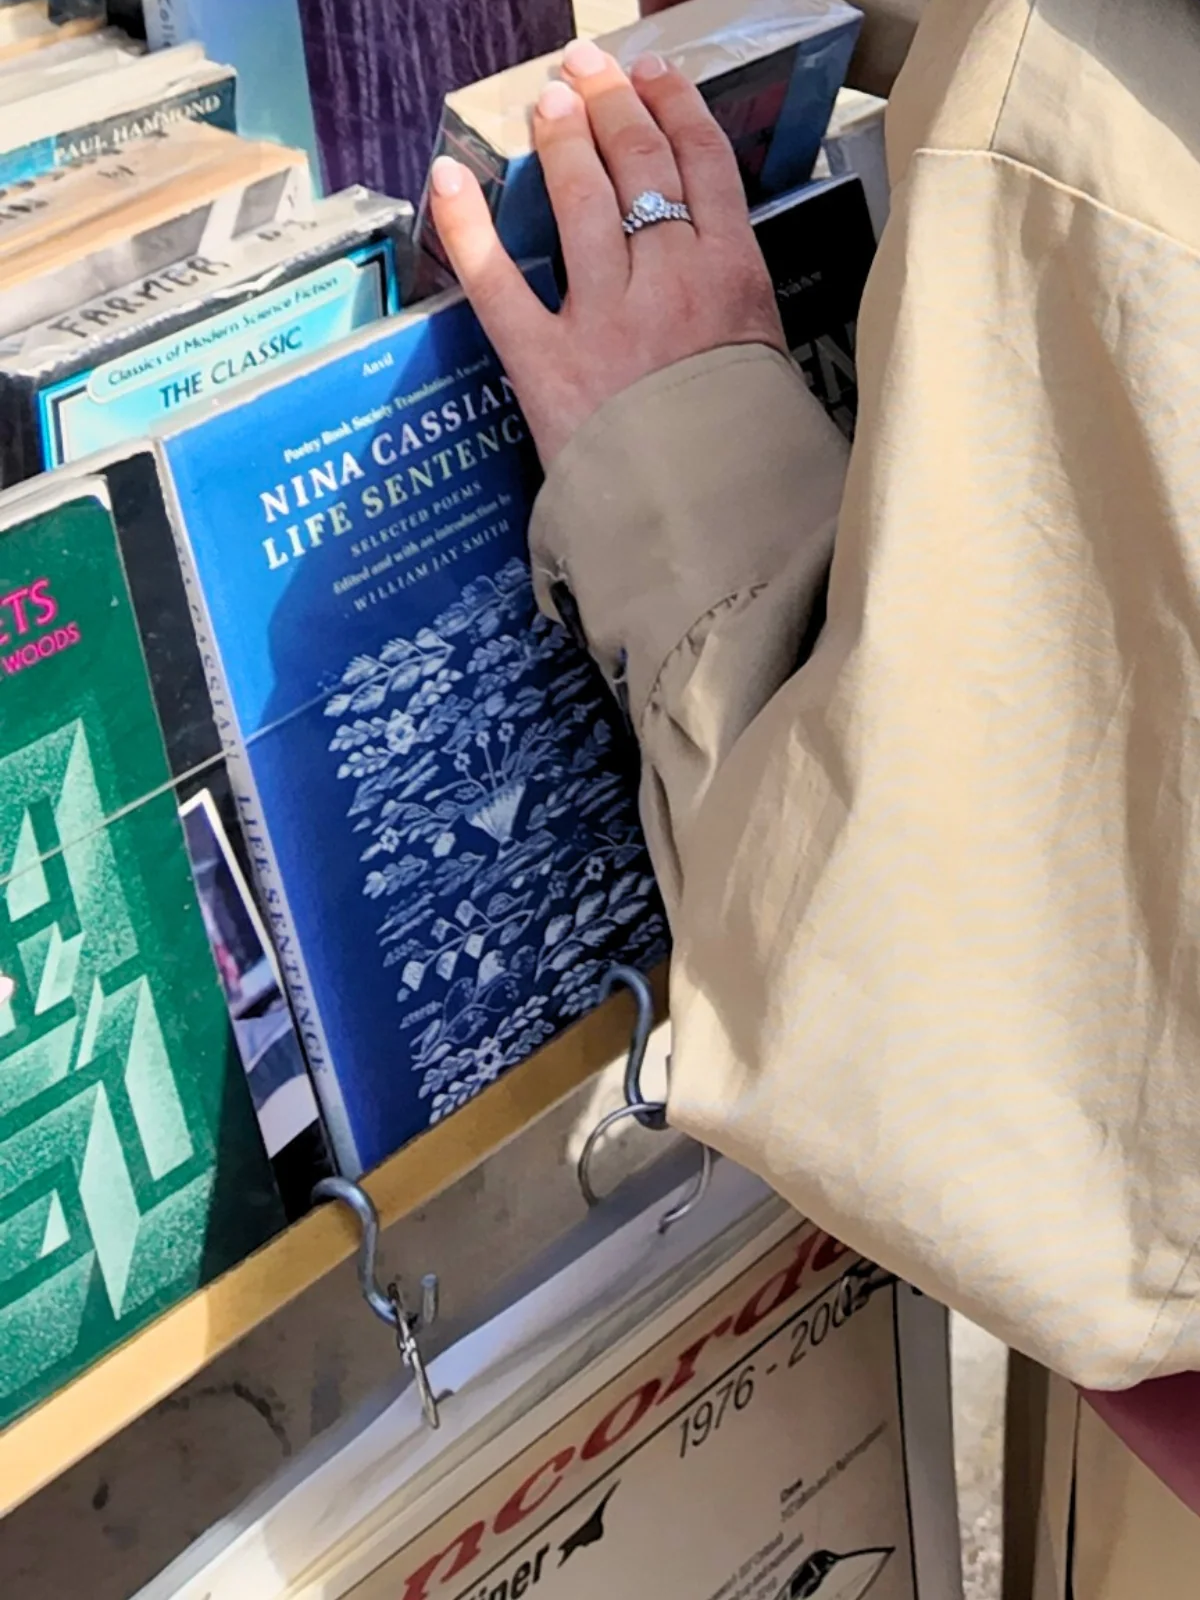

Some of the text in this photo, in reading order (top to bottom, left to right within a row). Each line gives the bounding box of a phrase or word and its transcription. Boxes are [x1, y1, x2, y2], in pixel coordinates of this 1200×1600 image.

[53, 94, 222, 168] PAUL HAMMOND
[48, 257, 234, 338] FARMER
[108, 275, 339, 387] Classics of Modern Science Fiction
[159, 326, 303, 409] THE CLASSIC
[361, 352, 395, 377] Anvil
[283, 437, 321, 464] Poetry
[321, 421, 352, 446] Book
[351, 403, 394, 432] Society
[394, 375, 456, 411] Translation
[259, 451, 365, 523] NINA
[262, 501, 353, 570] LIFE
[361, 413, 524, 519] SENTENC
[351, 479, 483, 557] SELECTED POEMS
[333, 565, 371, 594] Edited
[371, 556, 393, 576] and
[393, 541, 420, 564] with
[420, 533, 436, 549] an
[435, 499, 500, 541] introduction
[353, 519, 511, 611] WILLIAM JAY SMITH
[2, 620, 81, 676] WOODS
[237, 795, 271, 874] LIFE
[262, 887, 328, 1074] SENTENCE
[679, 1365, 754, 1458] 1976
[787, 1285, 869, 1369] 200
